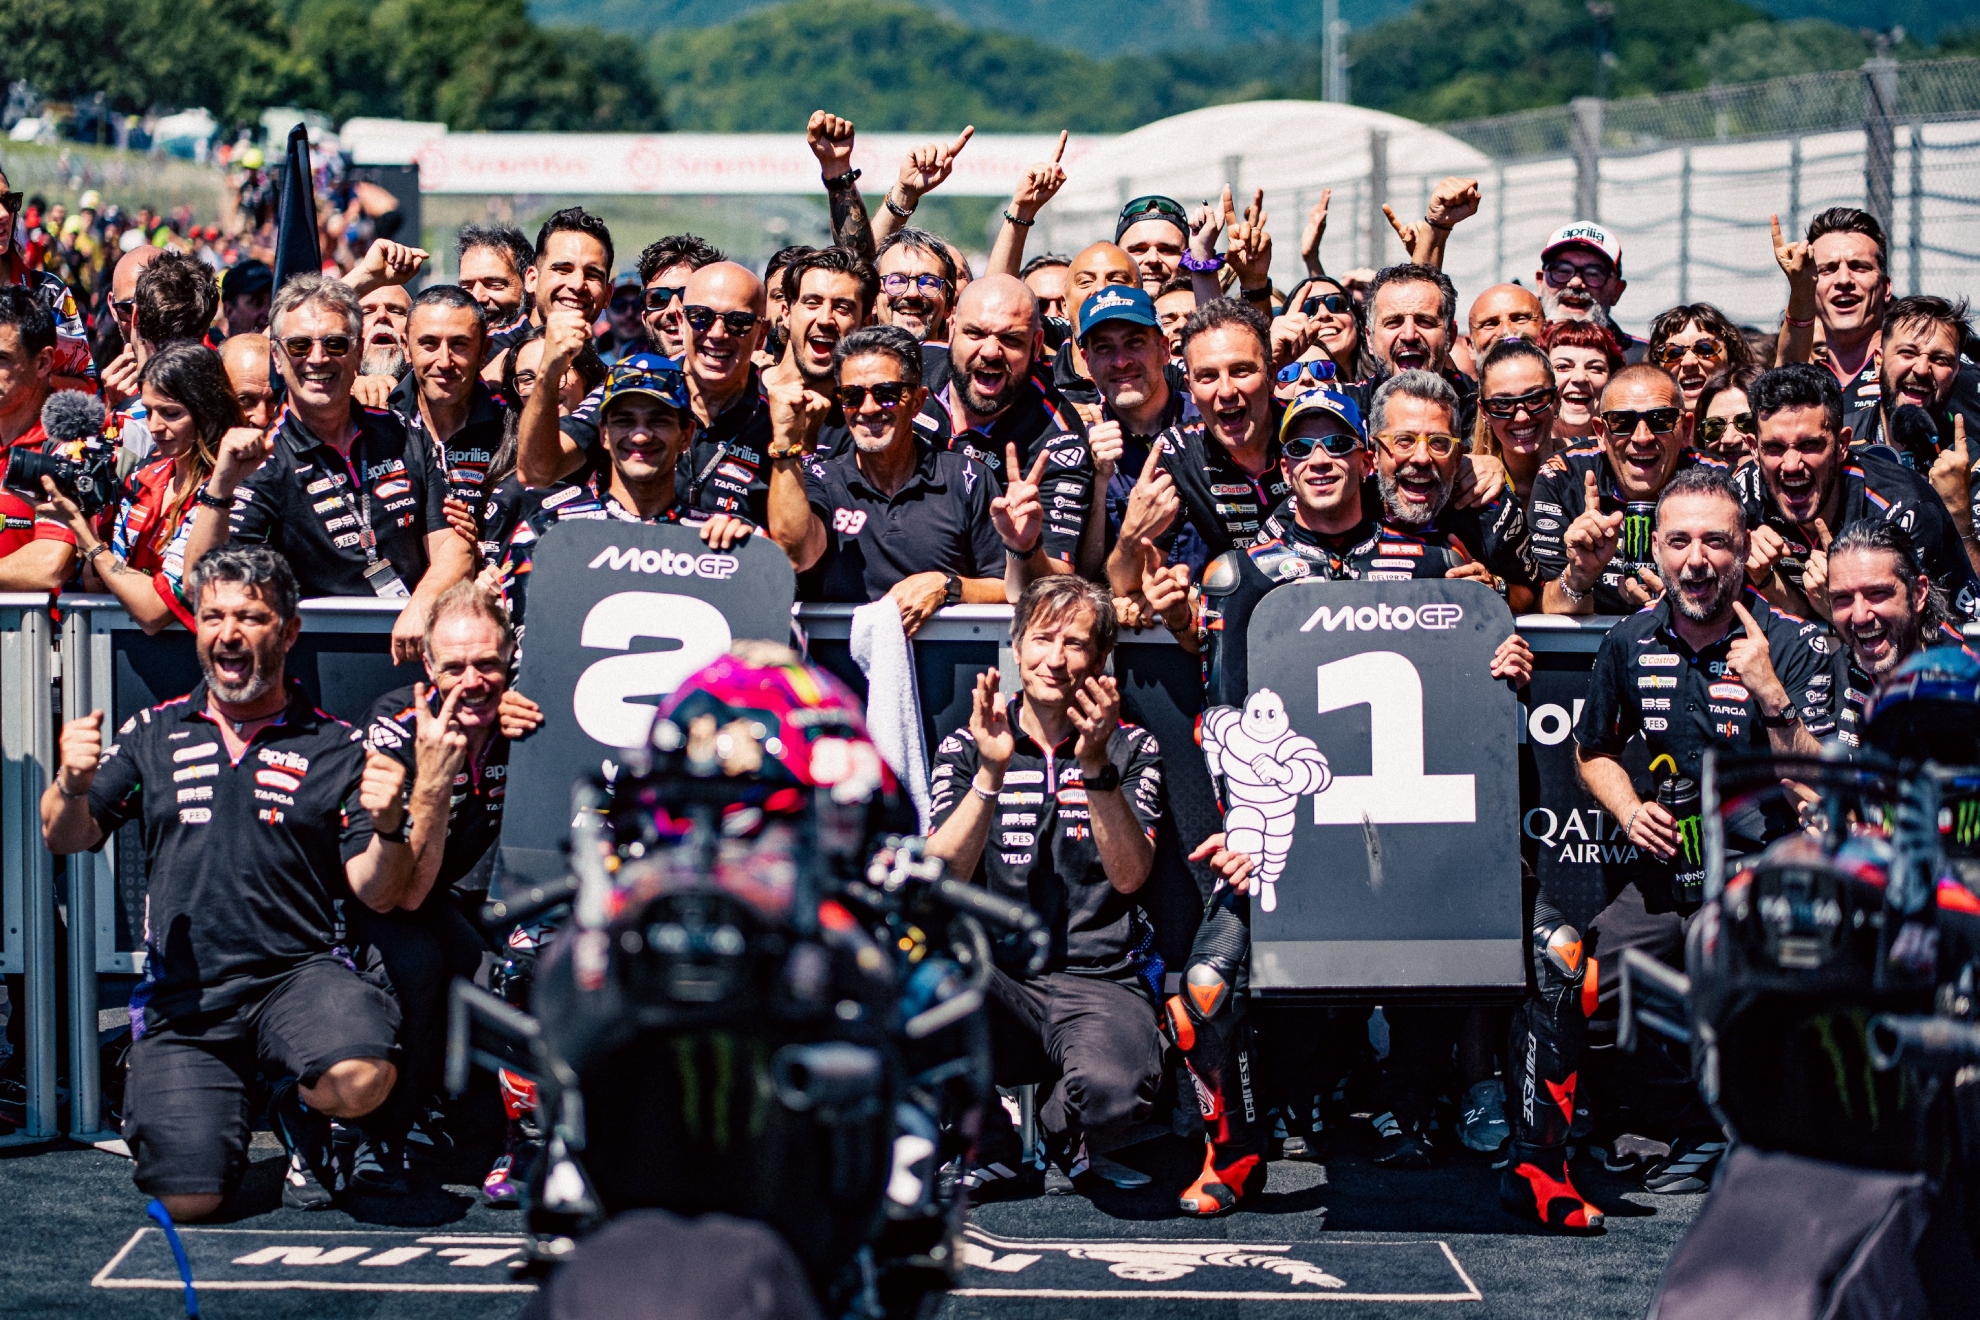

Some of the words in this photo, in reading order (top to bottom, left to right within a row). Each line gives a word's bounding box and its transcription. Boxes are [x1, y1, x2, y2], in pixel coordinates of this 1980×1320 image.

[1562, 227, 1605, 245] aprilia
[1854, 400, 1877, 408] TARG
[447, 447, 490, 463] aprilia
[964, 444, 1001, 470] aprilia
[367, 459, 405, 481] aprilia
[714, 479, 749, 495] TARGA
[1221, 485, 1251, 493] Castrol
[551, 486, 579, 505] Castrol
[384, 497, 416, 511] TARGA
[1226, 520, 1260, 531] BS
[342, 534, 358, 545] FES
[588, 546, 739, 579] MotoGP
[1300, 603, 1462, 632] MotoGP
[1648, 656, 1677, 665] Castrol
[573, 591, 732, 752] 2
[1641, 698, 1671, 708] BS
[1708, 704, 1747, 717] TARGA
[1649, 720, 1665, 729] FES
[1314, 651, 1476, 825] 1
[1009, 773, 1040, 782] Castrol
[253, 788, 295, 807] TARGA
[189, 810, 208, 819] FES
[1058, 809, 1091, 819] TARG
[1523, 807, 1630, 848] QAT
[1012, 835, 1031, 844] FES
[1001, 853, 1032, 865] VELO
[1558, 843, 1647, 864] AIRWA
[1675, 869, 1706, 883] MONS
[1238, 1050, 1256, 1123] DAINESE
[1523, 1031, 1537, 1127] DAINESE
